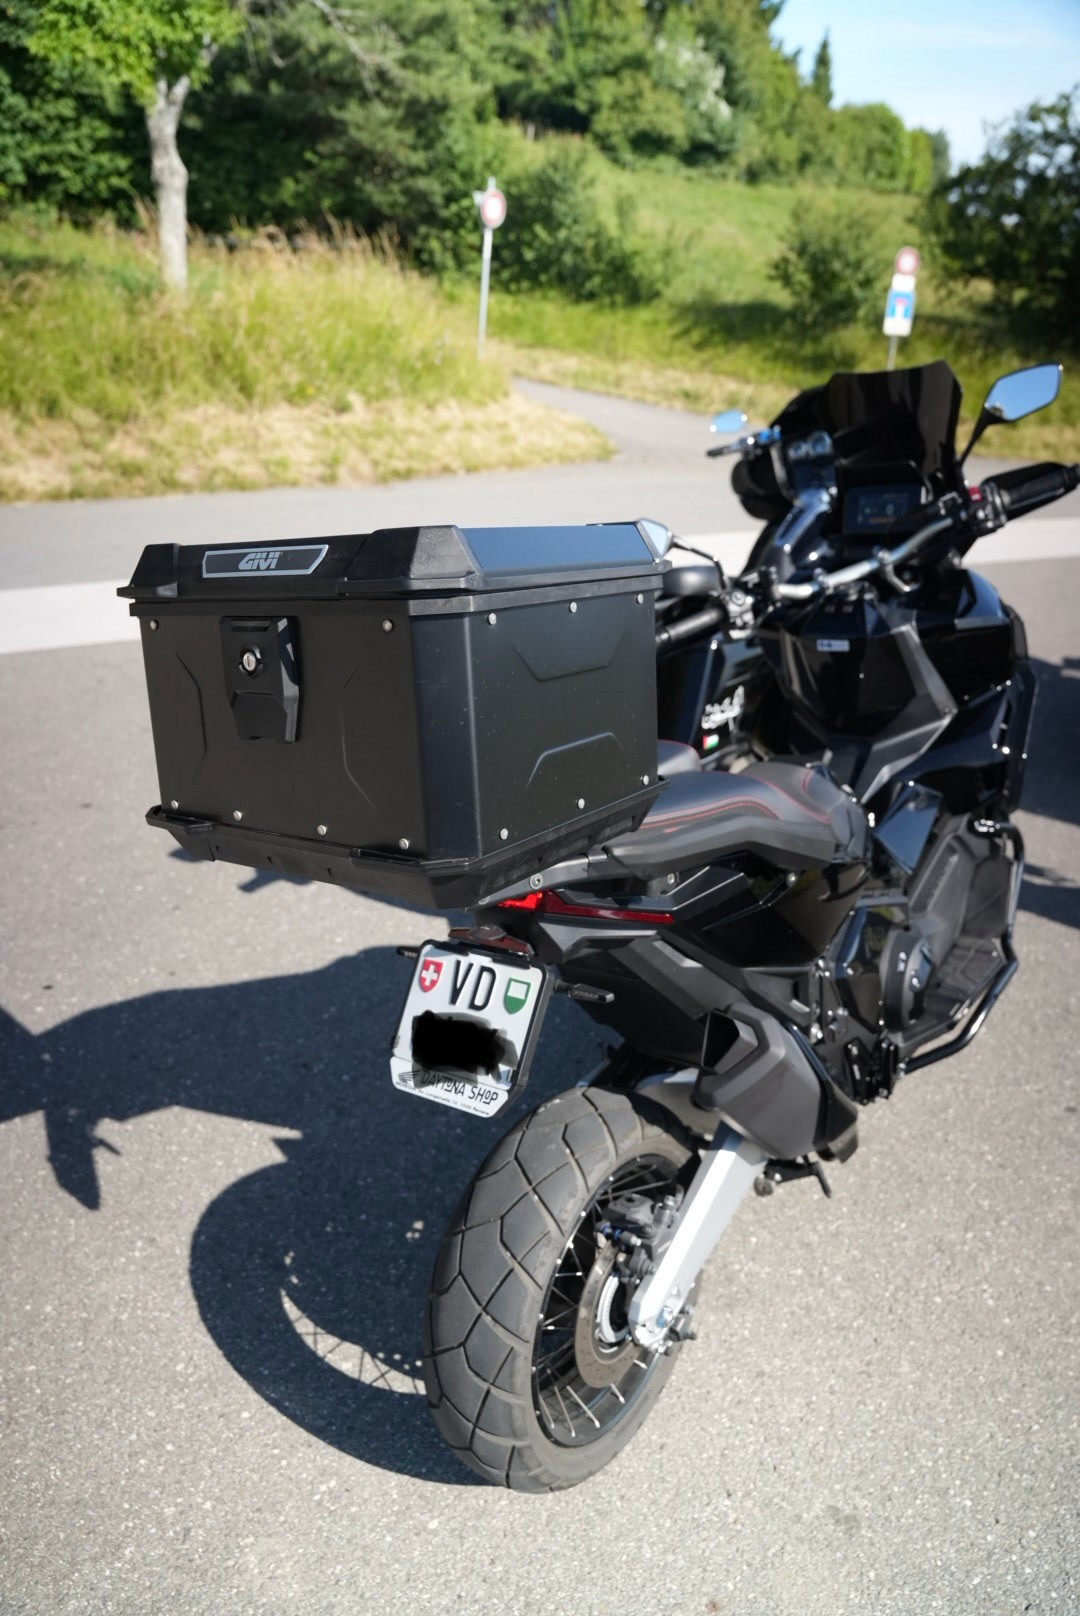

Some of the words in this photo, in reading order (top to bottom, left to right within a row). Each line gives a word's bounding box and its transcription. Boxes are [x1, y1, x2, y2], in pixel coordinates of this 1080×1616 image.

[238, 551, 281, 571] GIVI
[449, 959, 497, 1012] VD
[421, 1070, 466, 1097] DAYTONA
[468, 1085, 499, 1105] SHOP
